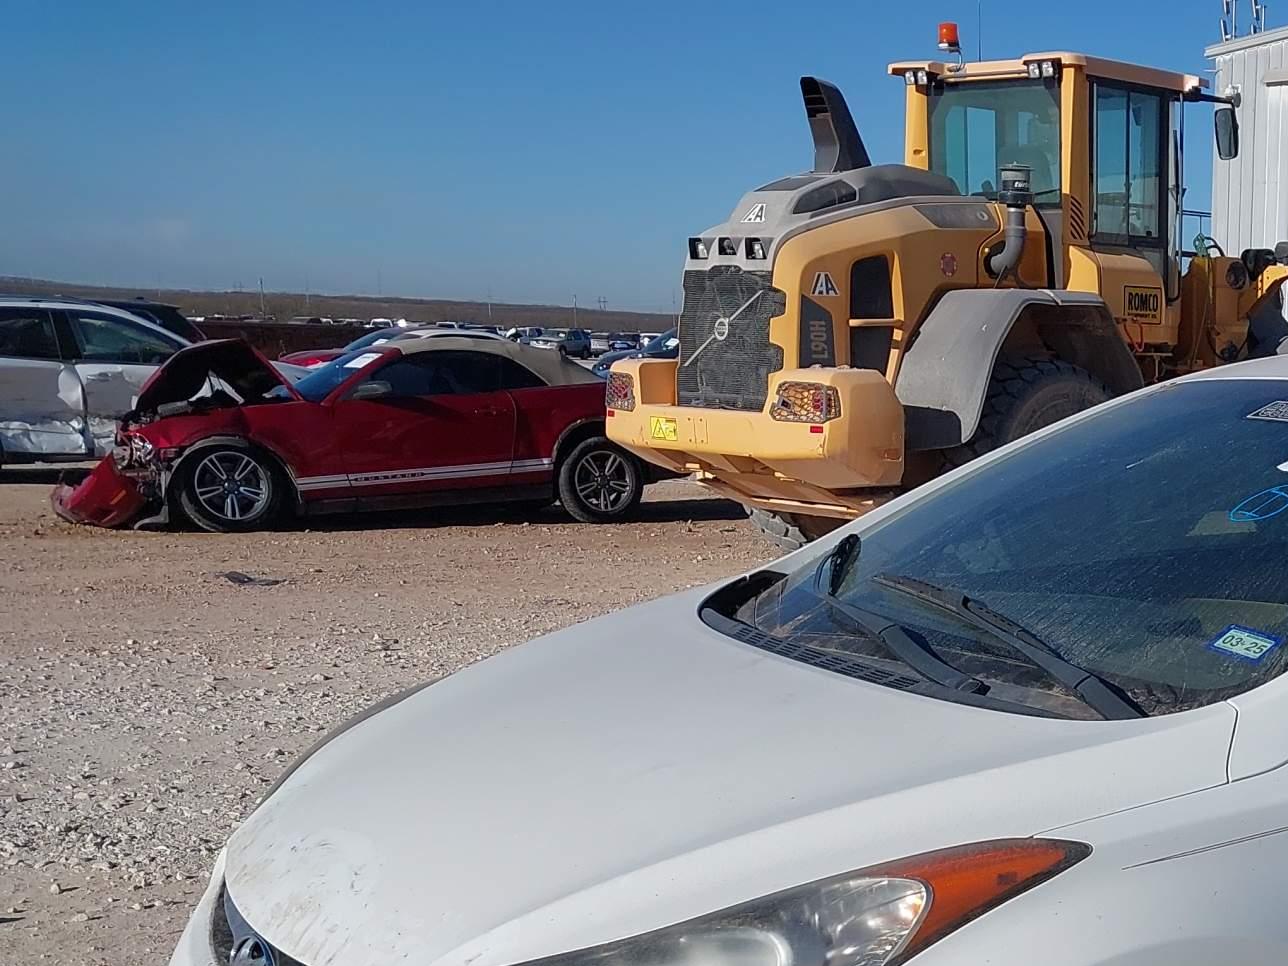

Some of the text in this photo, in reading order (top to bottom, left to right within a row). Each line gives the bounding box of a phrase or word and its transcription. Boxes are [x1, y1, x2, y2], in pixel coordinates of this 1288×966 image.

[1127, 292, 1159, 312] ROMCO
[810, 320, 828, 359] L90H
[1222, 634, 1243, 647] 03
[1244, 641, 1268, 654] 25
